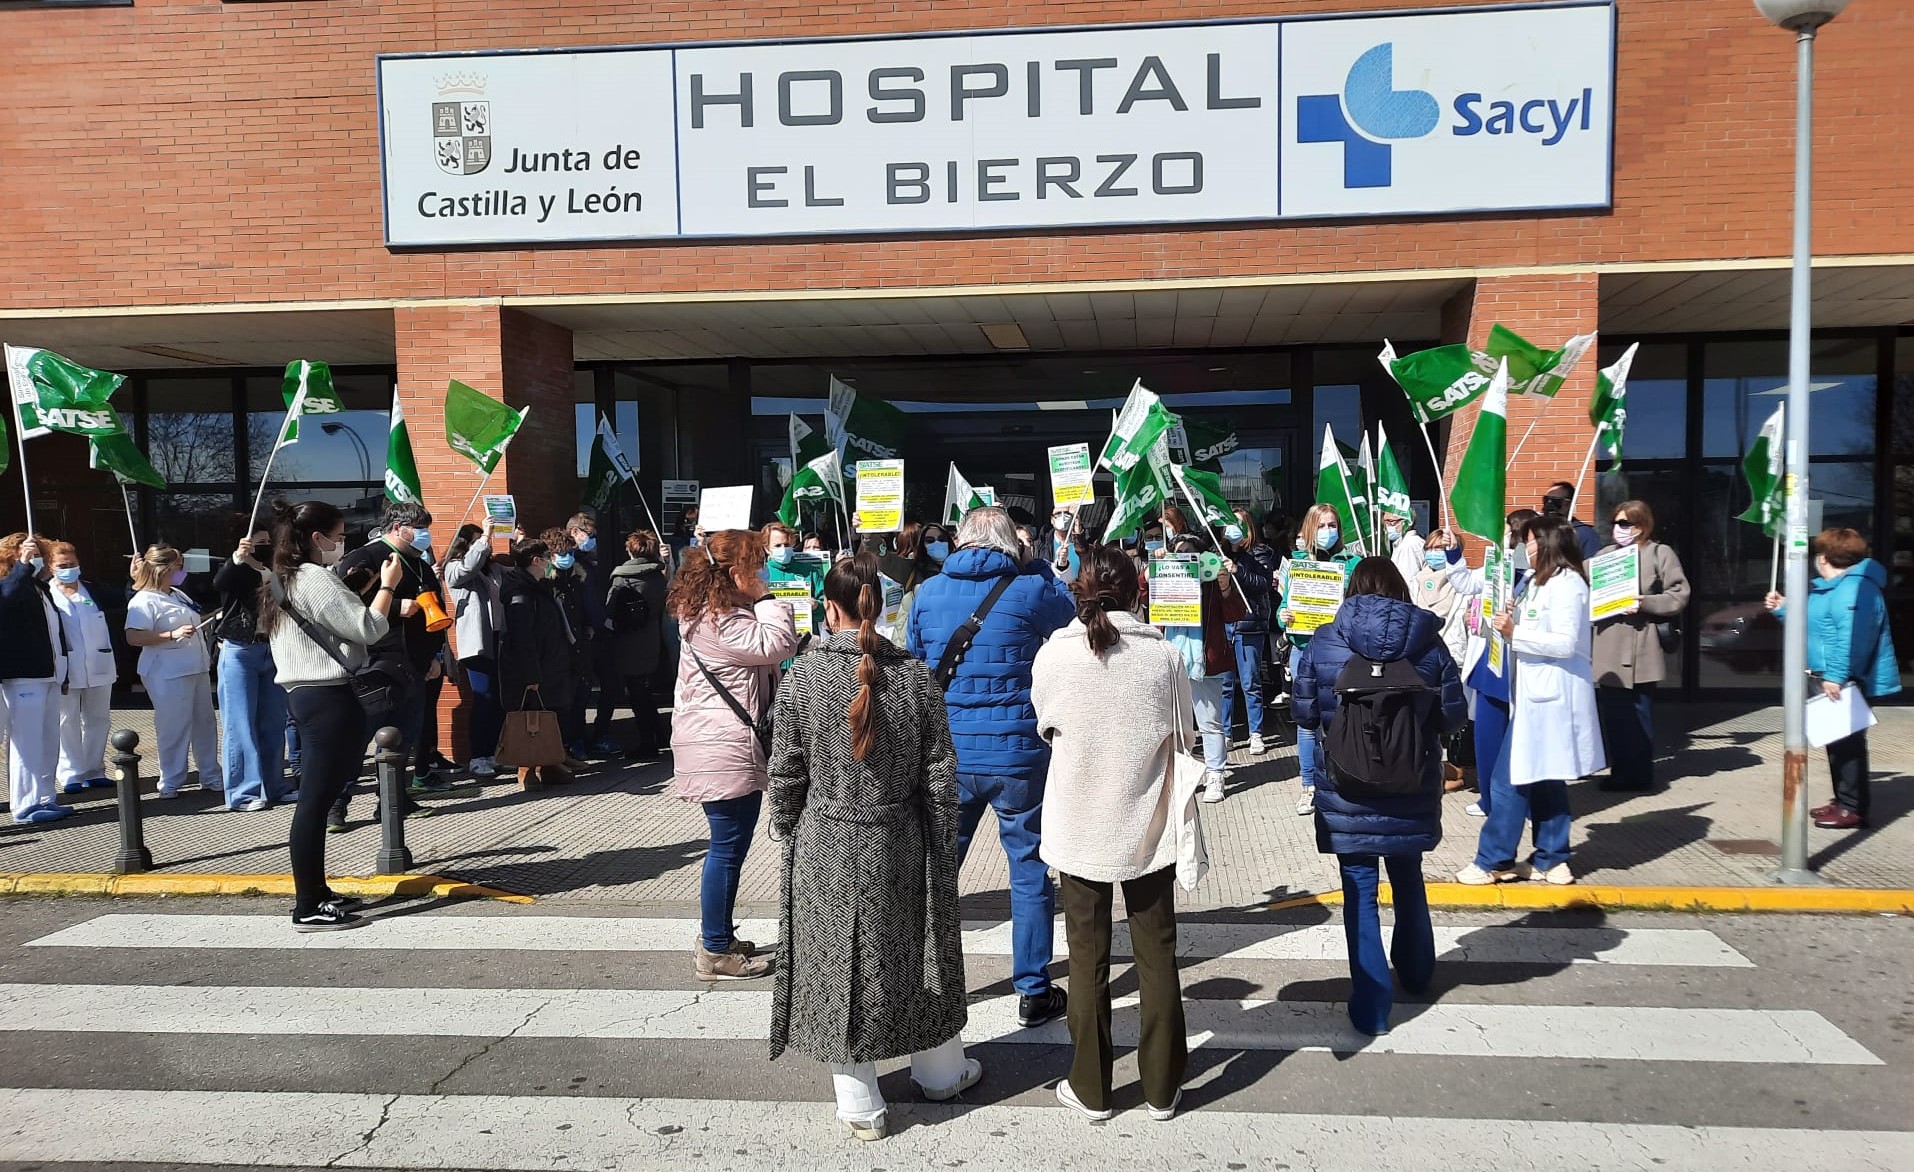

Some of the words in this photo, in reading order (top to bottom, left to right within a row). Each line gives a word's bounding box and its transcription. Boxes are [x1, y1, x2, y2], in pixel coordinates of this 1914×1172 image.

[690, 53, 1261, 129] HOSPITAL
[1452, 88, 1593, 146] Sacyl
[504, 147, 590, 174] Junta
[603, 145, 640, 170] de
[747, 166, 844, 208] EL
[886, 151, 1204, 205] BIERZO
[418, 188, 527, 218] Castilla
[537, 196, 555, 222] y
[567, 186, 642, 215] León
[36, 408, 116, 429] SATSE
[1195, 432, 1240, 462] SATSE
